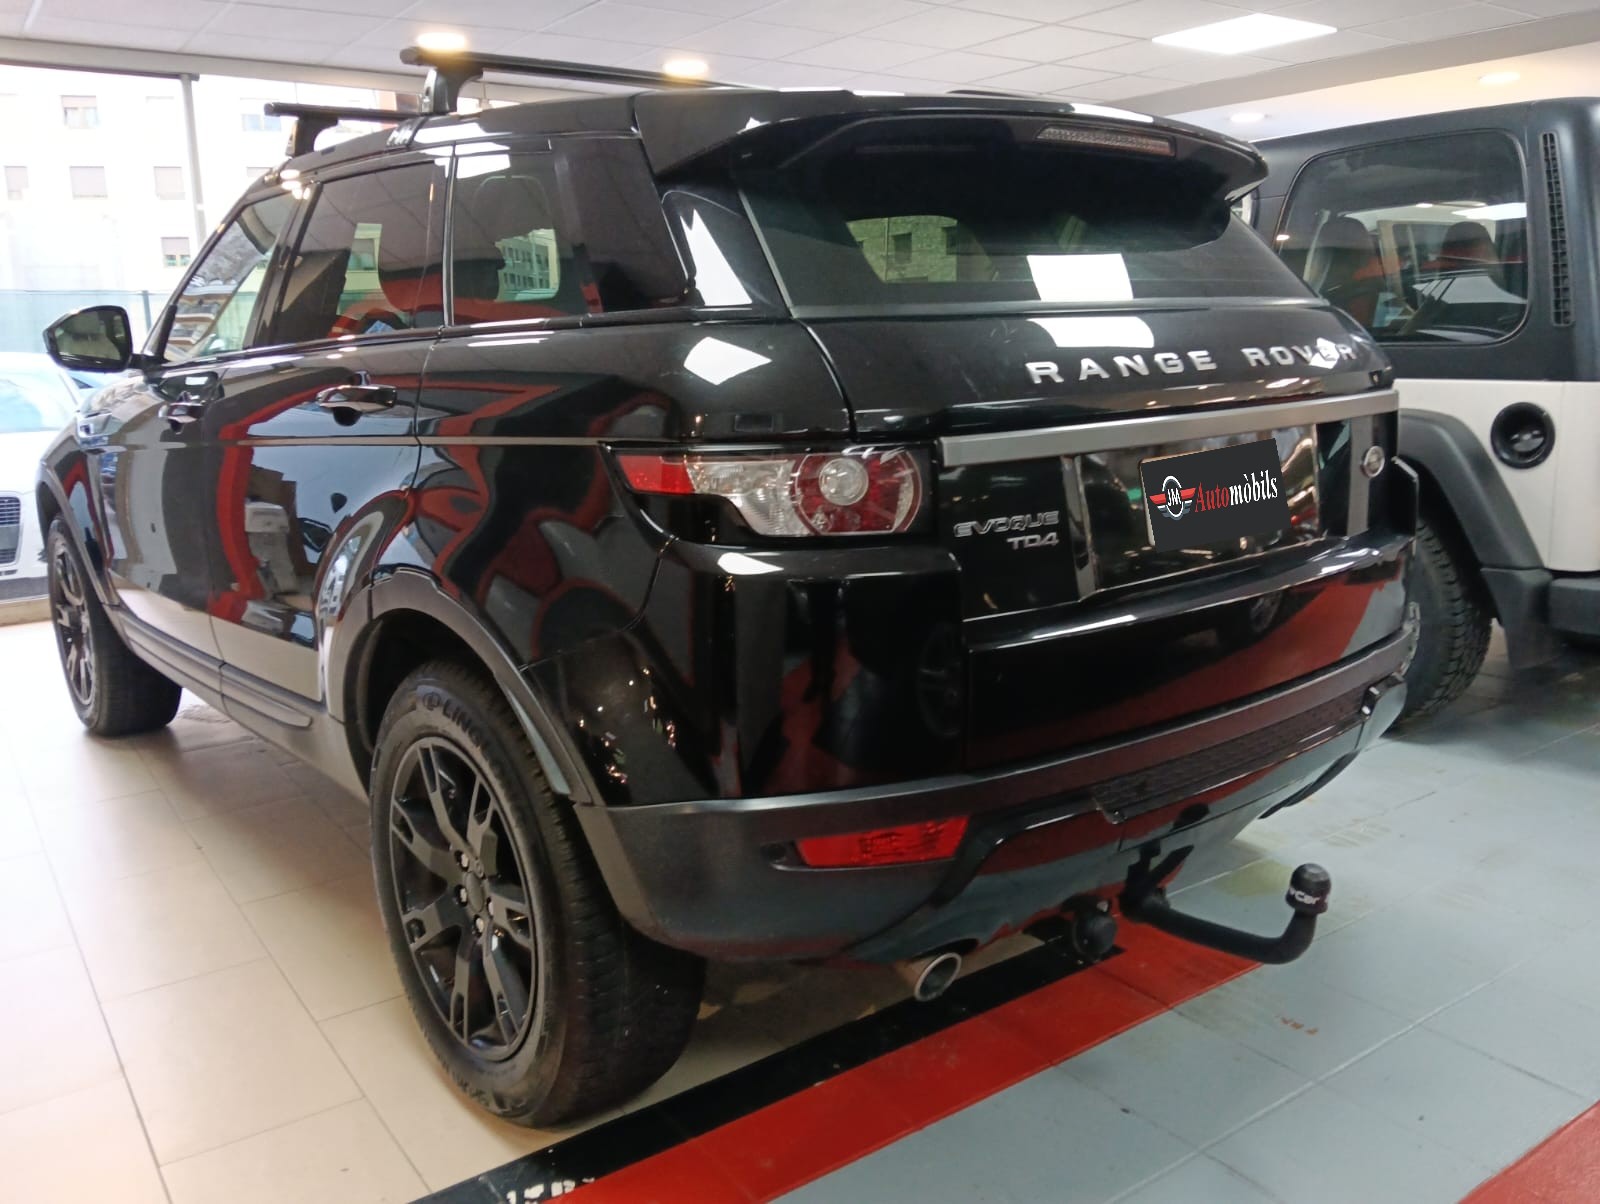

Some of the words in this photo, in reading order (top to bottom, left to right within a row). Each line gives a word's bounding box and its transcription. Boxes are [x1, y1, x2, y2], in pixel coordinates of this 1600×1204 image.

[1024, 349, 1218, 385] RANGE
[953, 510, 1060, 538] EVOQUE
[1006, 531, 1060, 550] TD4
